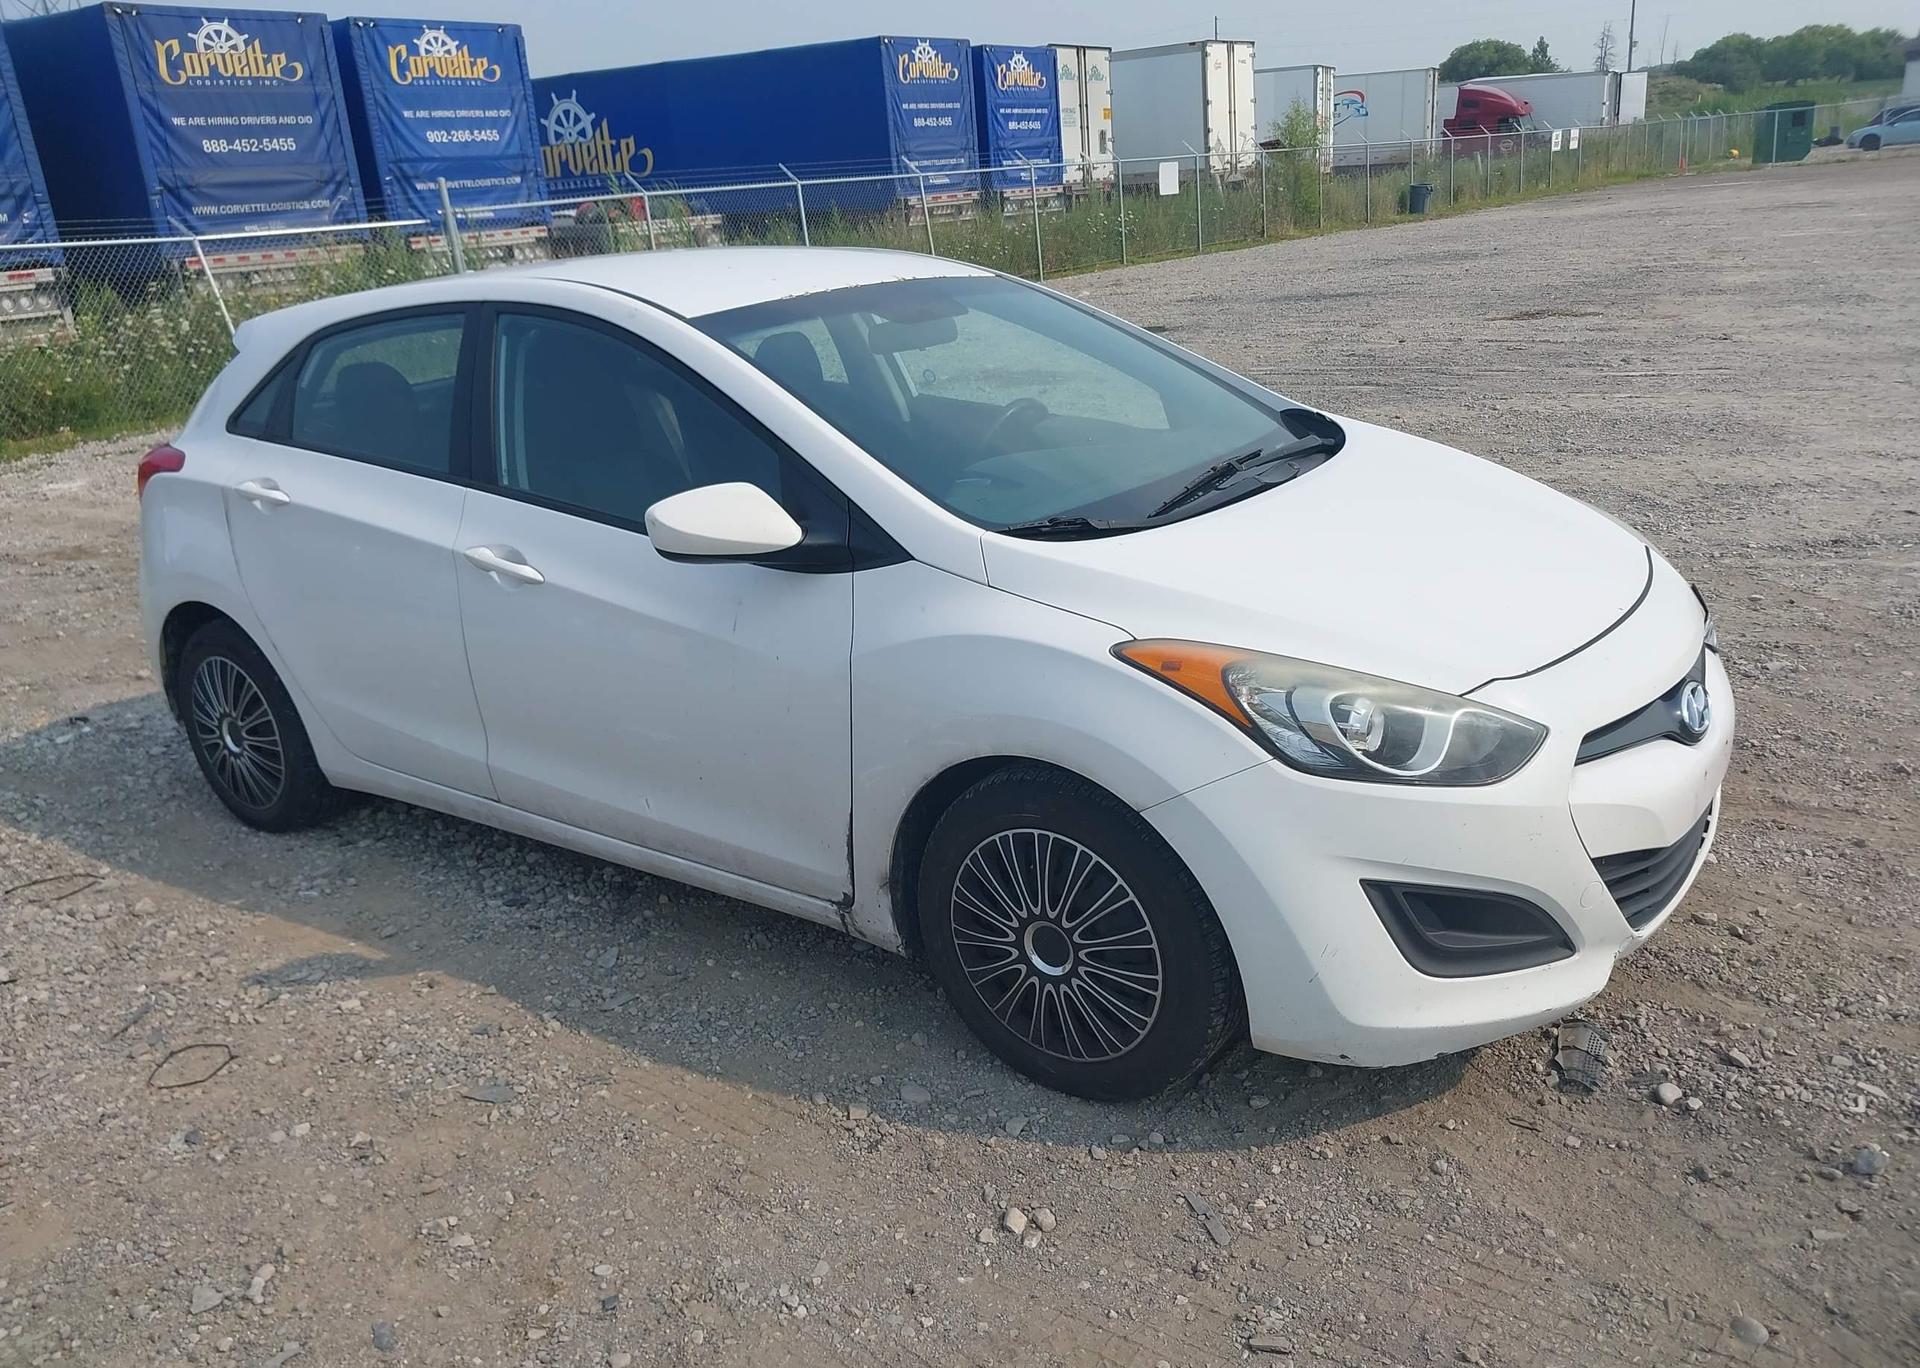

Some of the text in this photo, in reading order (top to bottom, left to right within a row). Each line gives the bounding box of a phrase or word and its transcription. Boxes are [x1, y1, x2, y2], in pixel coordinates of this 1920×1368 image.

[154, 38, 304, 86] Corvette
[388, 43, 501, 85] Corvette
[898, 53, 959, 84] Corvette
[189, 79, 253, 87] LOGISTICS
[997, 63, 1046, 91] Corvette
[171, 116, 187, 127] WE
[188, 116, 207, 126] ARE
[208, 116, 240, 126] HIRING
[240, 115, 277, 125] DRIVERS
[278, 115, 297, 125] AND
[415, 110, 431, 118] ARE
[431, 110, 456, 118] HIRING
[456, 110, 485, 118] DRIVERS
[485, 110, 499, 118] AND
[426, 130, 500, 143] 902-266-5455
[202, 137, 297, 153] 888-452-5455
[541, 117, 654, 178] orvette
[415, 176, 522, 191] WWW.RVETTELOGISTICS.COM
[192, 199, 331, 216] WWW.CORVETTELOGISTICS.COM
